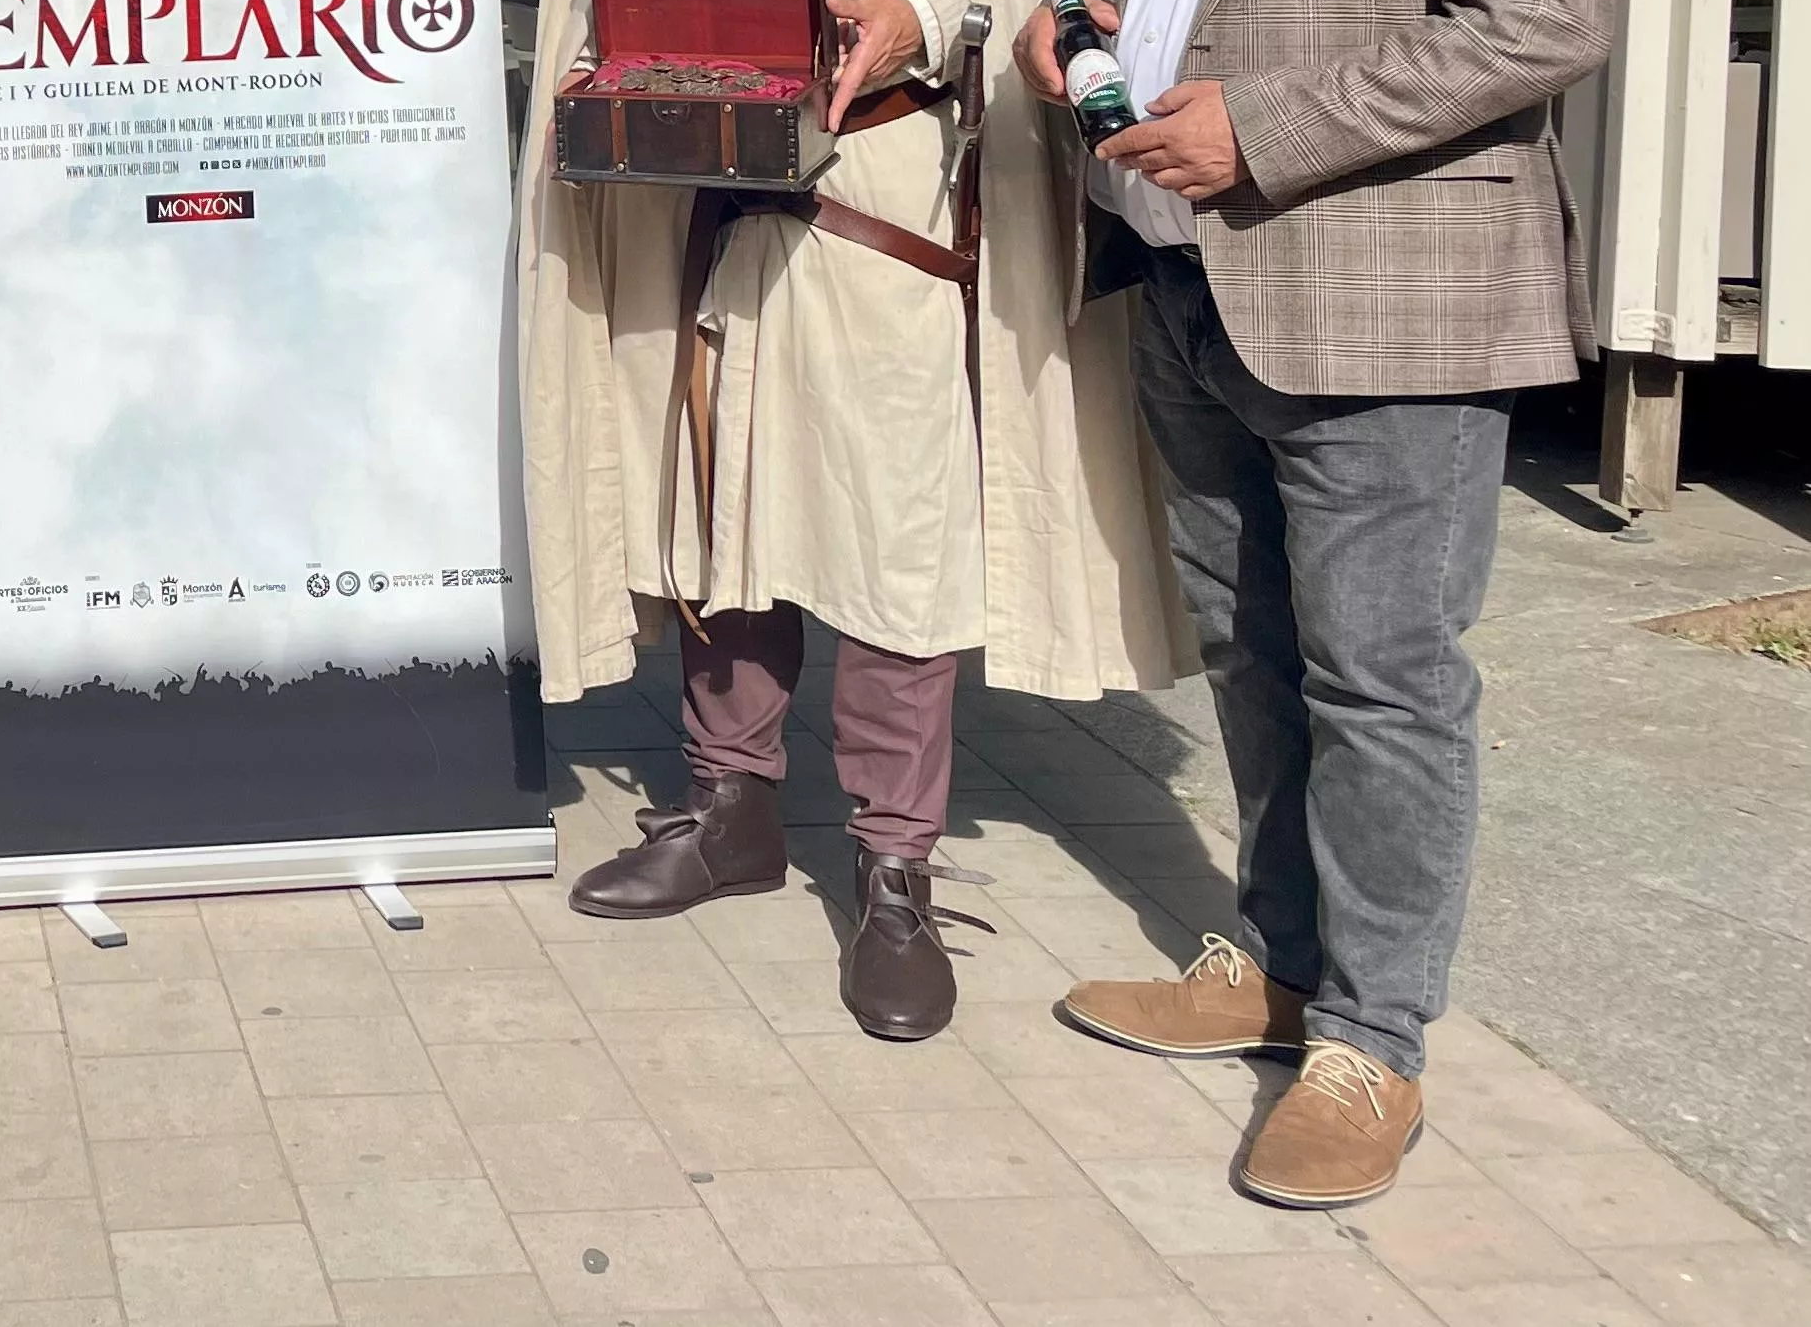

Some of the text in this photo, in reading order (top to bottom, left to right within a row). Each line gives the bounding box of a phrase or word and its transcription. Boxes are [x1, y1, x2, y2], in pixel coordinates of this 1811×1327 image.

[9, 85, 16, 100] I
[24, 84, 37, 100] Y
[44, 81, 135, 98] GUILLEM
[143, 78, 170, 94] DE
[176, 69, 323, 93] MONT-RODÓN
[12, 124, 47, 140] LLEGADA
[50, 123, 65, 138] DEL
[68, 122, 83, 138] REY
[86, 121, 111, 136] JAIME
[121, 120, 131, 135] DE
[134, 117, 167, 134] ARAGÓN
[179, 115, 213, 132] MONZÓN
[223, 115, 263, 131] MERCADO
[266, 112, 304, 129] MEDIEVAL
[308, 112, 317, 127] DE
[321, 111, 346, 126] ARTES
[357, 109, 389, 125] OFICIOS
[392, 107, 456, 123] TRADICIONALES
[12, 143, 61, 161] HISTÓRICAS
[72, 142, 102, 158] TORNEO
[106, 140, 144, 156] MEDIEVAL
[156, 137, 192, 153] CABALLO
[203, 134, 259, 151] CAMPAMENTO
[262, 134, 272, 149] DE
[276, 131, 325, 149] RECREACIÓN
[328, 129, 370, 146] HISTÓRICA
[380, 127, 418, 143] POBLADO
[421, 127, 431, 141] DE
[157, 193, 243, 218] MONZÓN
[28, 585, 69, 596] OFICIOS
[182, 582, 223, 594] Monzón
